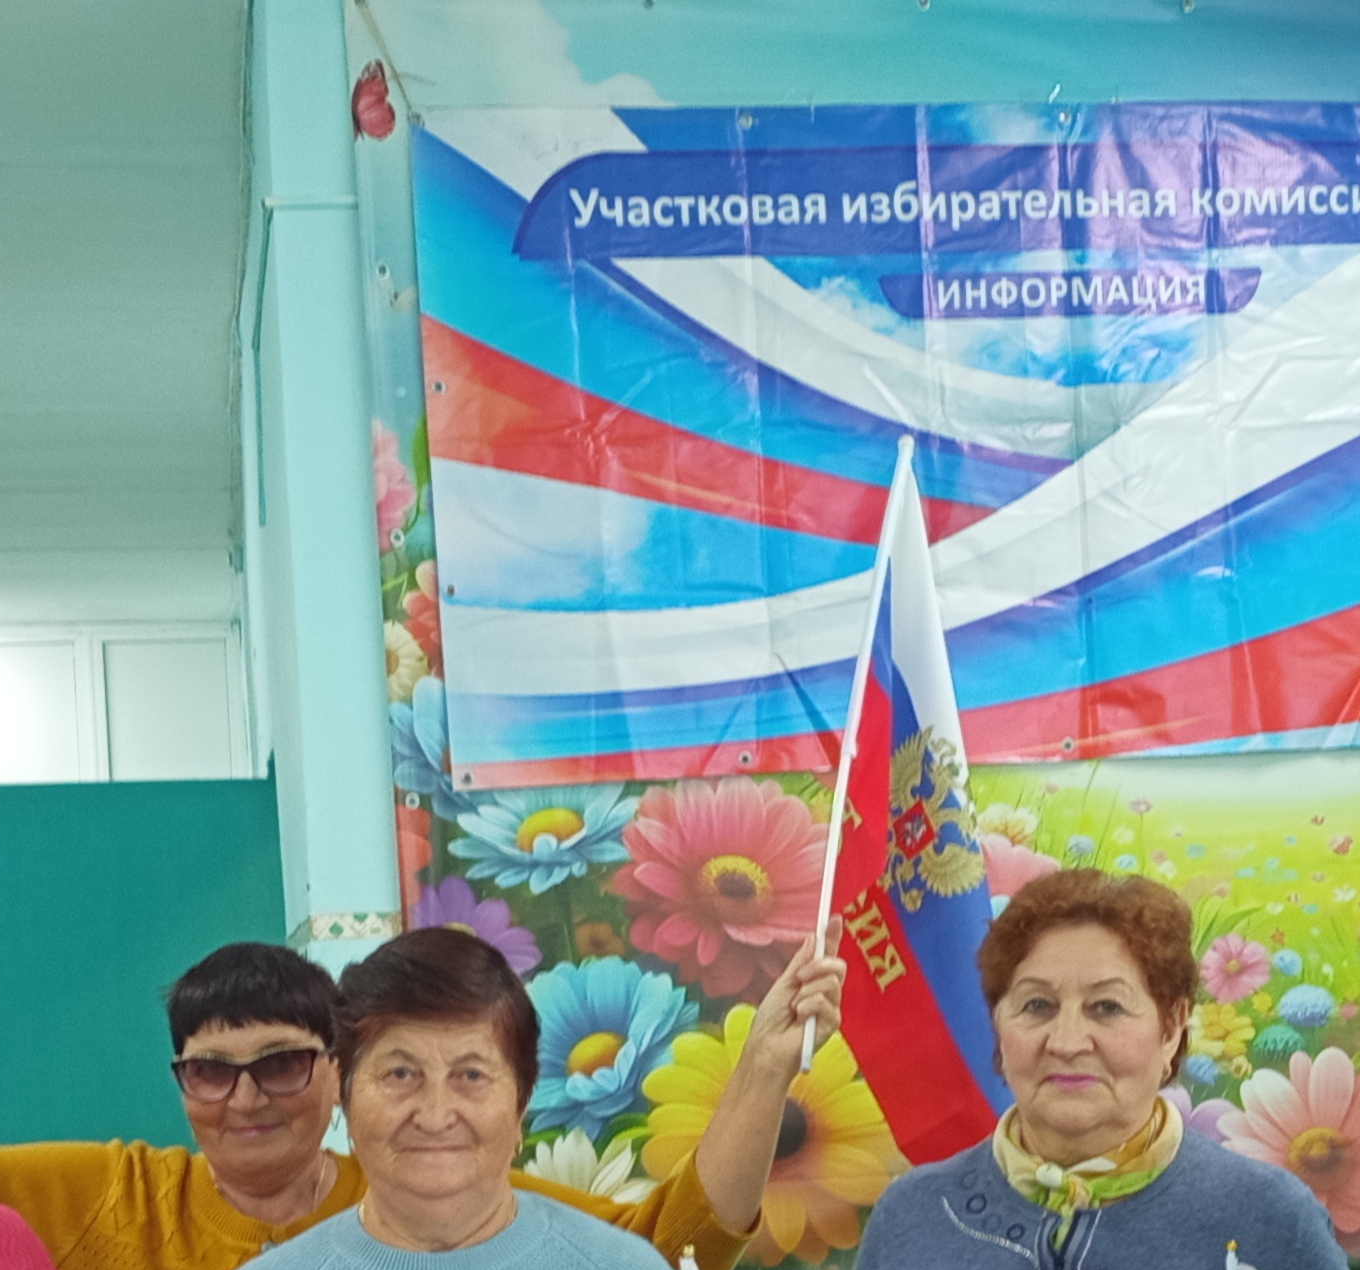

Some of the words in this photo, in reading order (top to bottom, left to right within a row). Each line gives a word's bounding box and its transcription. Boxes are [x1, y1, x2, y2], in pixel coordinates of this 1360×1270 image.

[568, 186, 827, 228] Участковая
[842, 179, 1177, 231] избирательная
[936, 273, 1207, 312] ИНФОРМАЦИЯ
